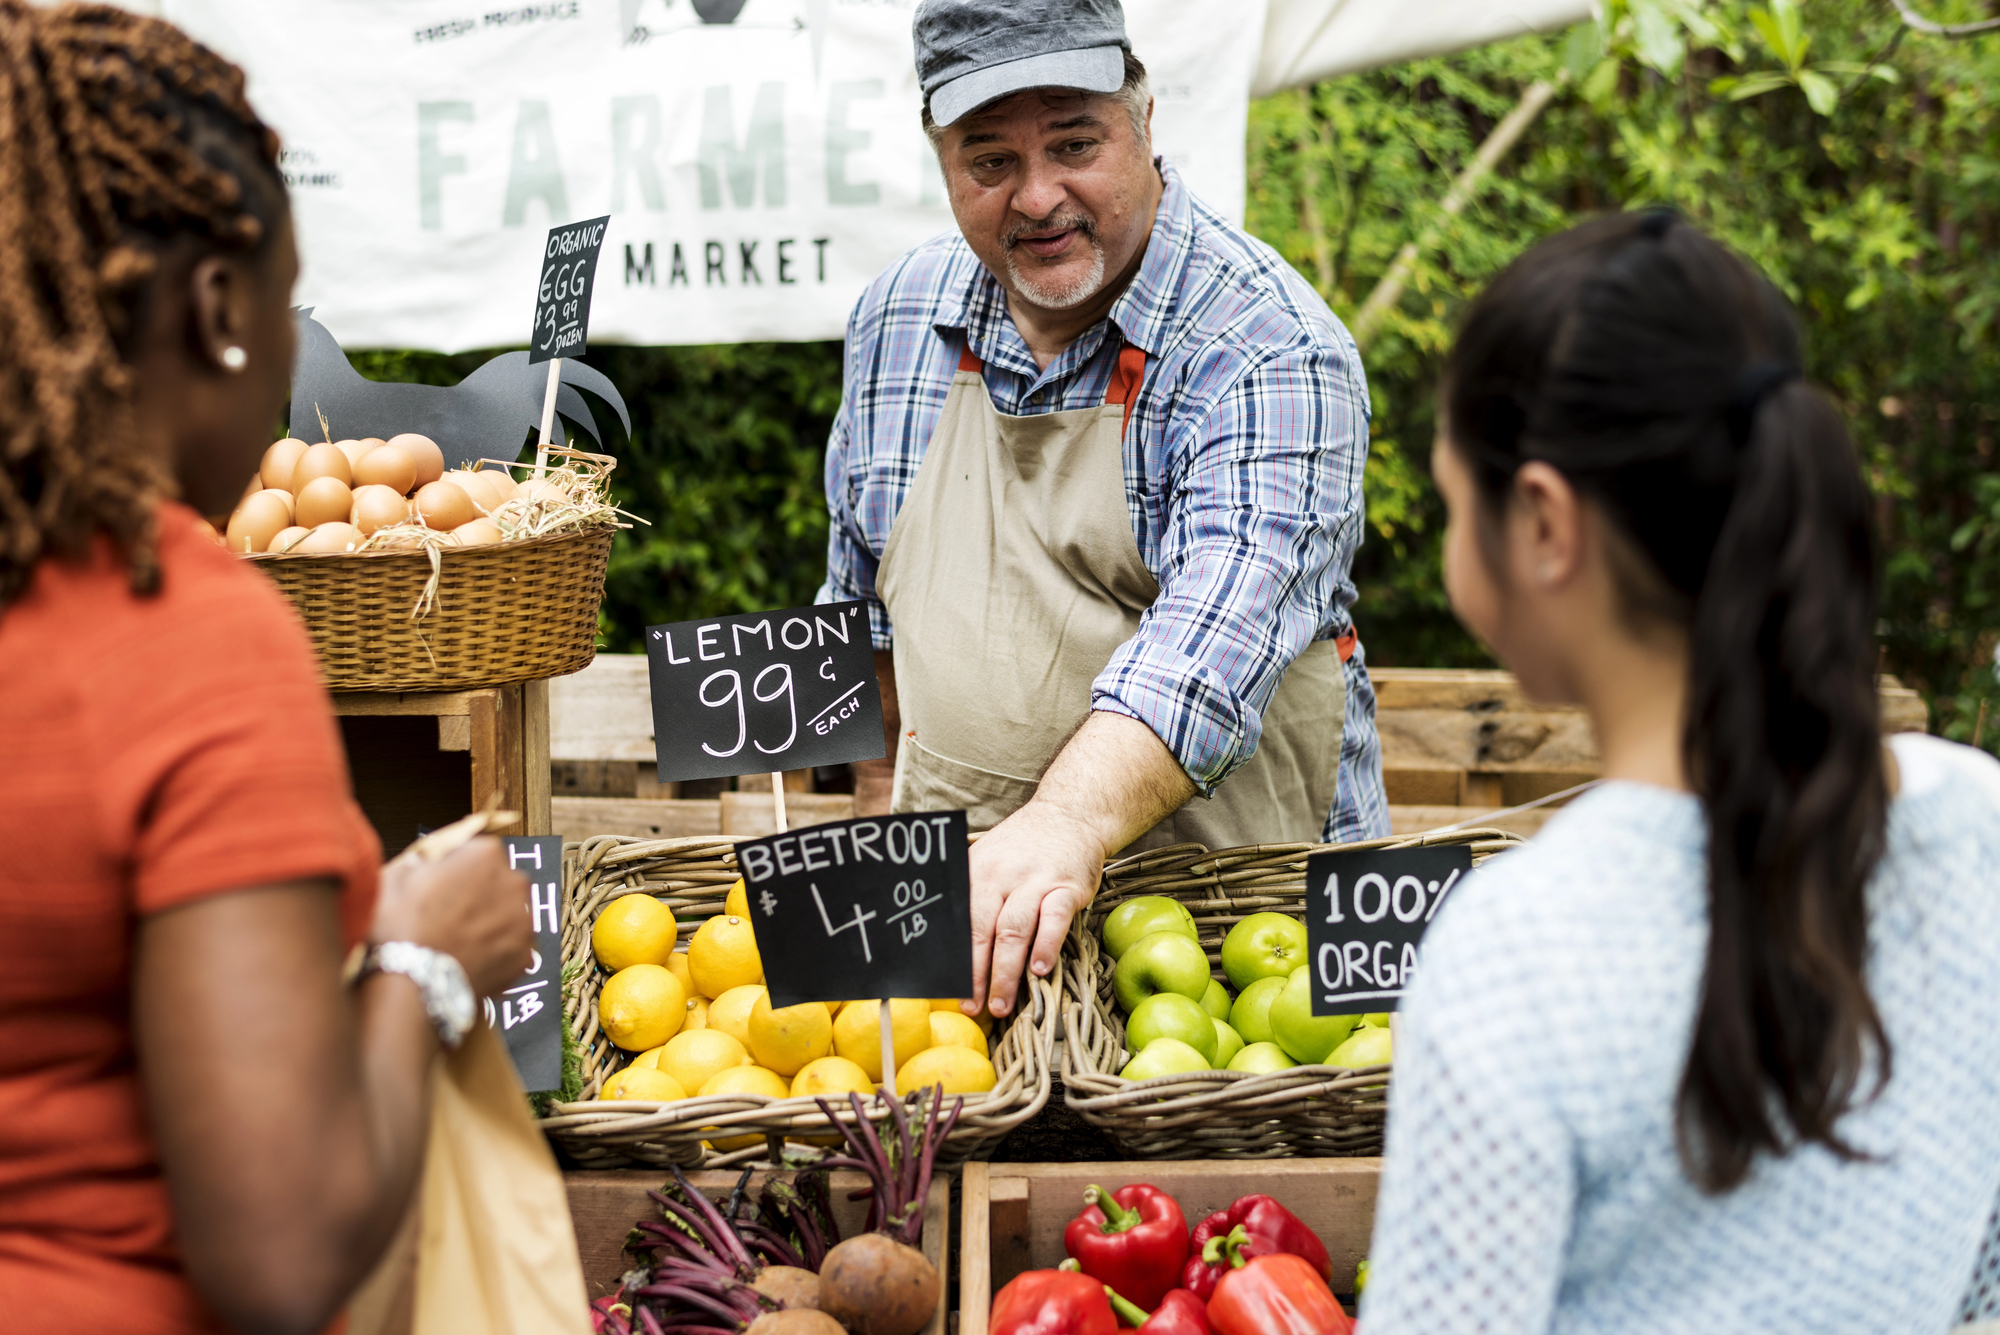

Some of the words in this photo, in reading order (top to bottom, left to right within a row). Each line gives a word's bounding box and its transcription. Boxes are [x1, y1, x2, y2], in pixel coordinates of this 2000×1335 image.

[483, 1, 580, 25] PRODUCE
[547, 223, 604, 259] ORGANIC
[624, 238, 831, 287] MARKET
[540, 259, 586, 303] EGG
[554, 327, 583, 356] DOZEN
[699, 663, 797, 758] 99
[815, 697, 860, 736] EACH
[741, 817, 951, 882] BEETROOT
[1323, 867, 1460, 924] 100%
[810, 882, 877, 963] 4
[901, 913, 928, 945] LB
[1317, 940, 1420, 990] ORGA
[502, 991, 544, 1030] LB
